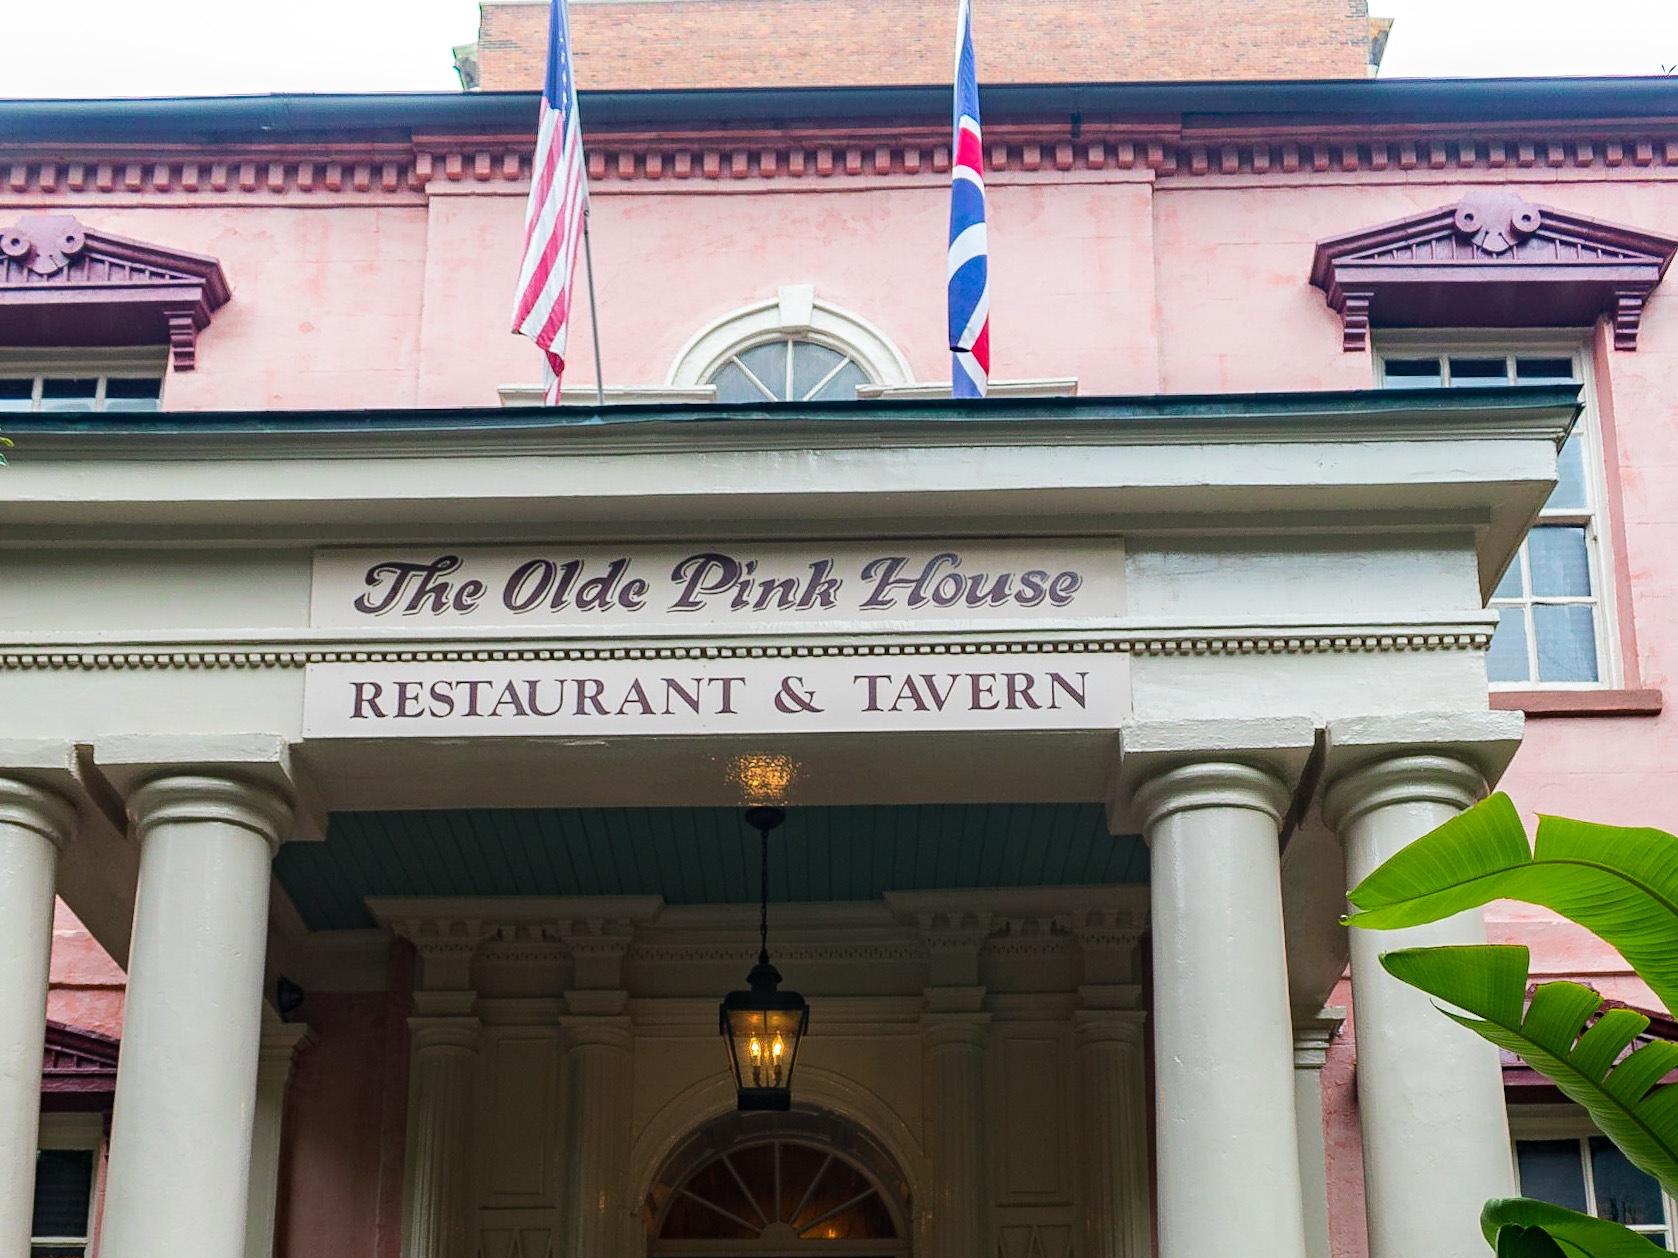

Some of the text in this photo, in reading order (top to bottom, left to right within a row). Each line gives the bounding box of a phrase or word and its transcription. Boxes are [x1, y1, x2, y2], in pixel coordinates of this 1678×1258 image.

[354, 552, 1083, 616] The Olde Pink House
[349, 671, 1090, 719] RESTAURANT & TAVERN
